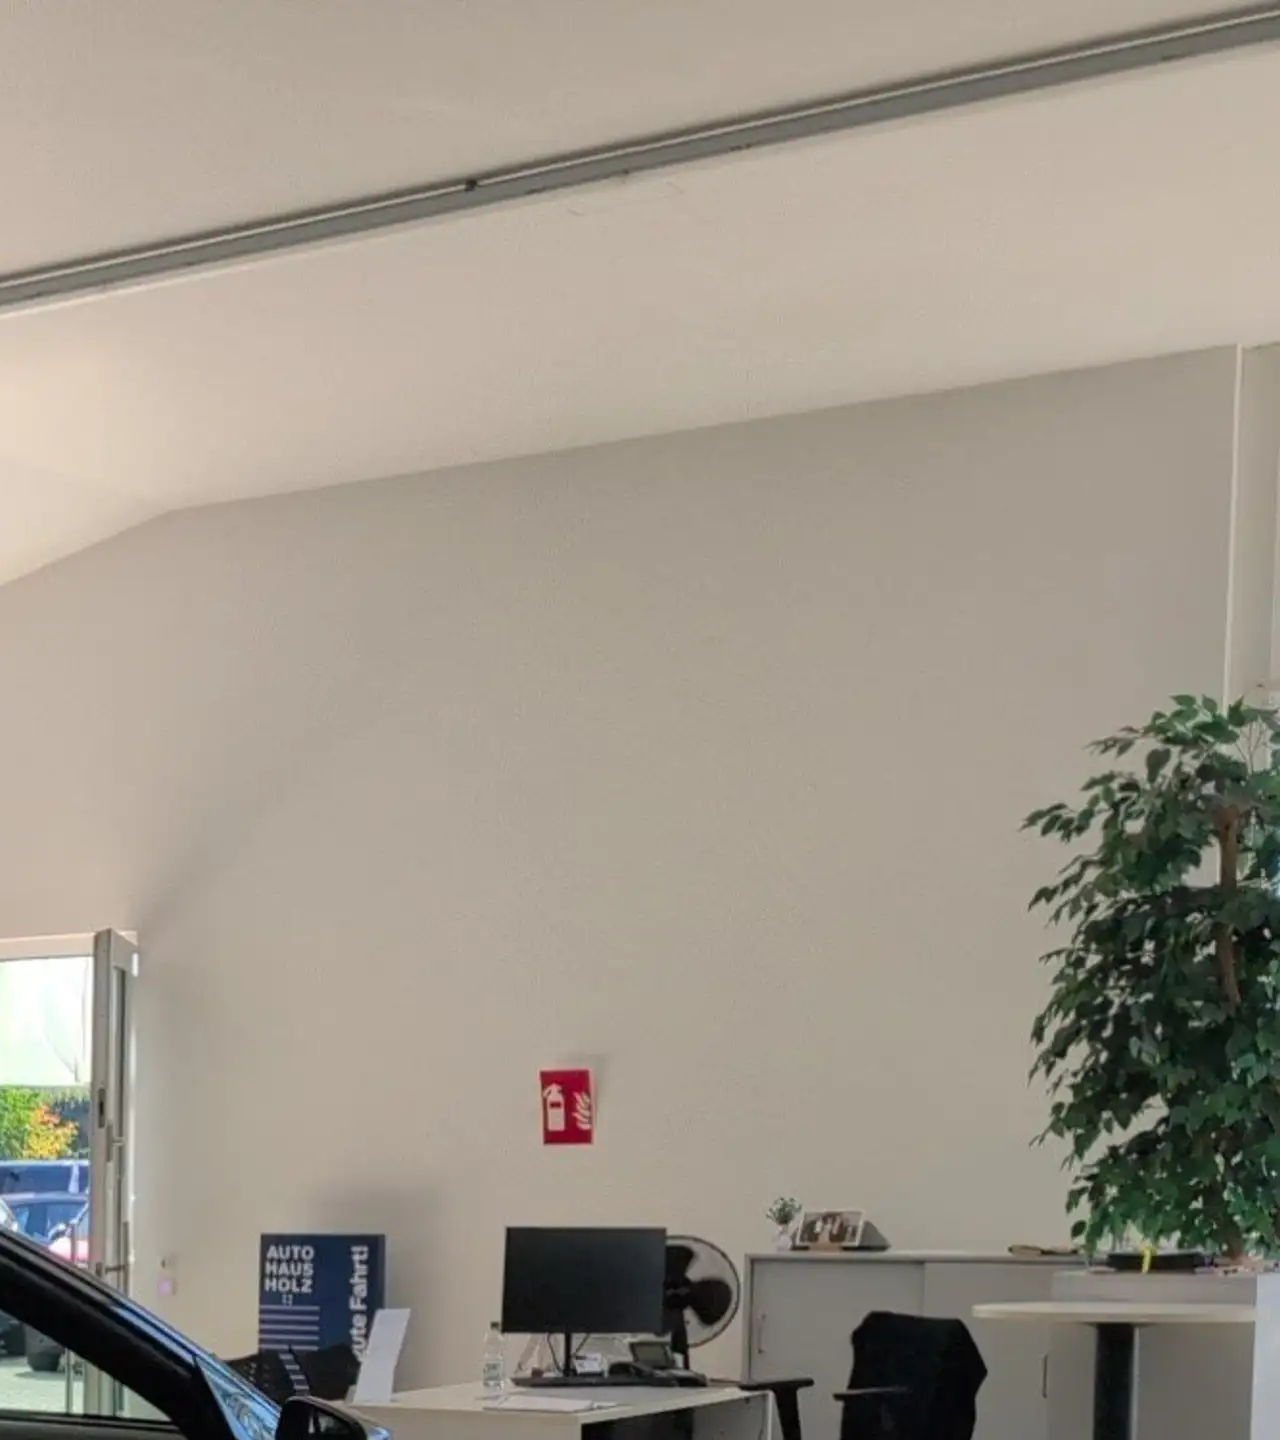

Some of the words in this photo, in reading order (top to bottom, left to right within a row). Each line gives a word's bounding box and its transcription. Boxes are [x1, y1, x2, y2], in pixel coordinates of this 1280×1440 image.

[267, 1245, 314, 1260] AUTO
[265, 1261, 314, 1276] HAUS
[264, 1277, 312, 1292] HOLZ
[349, 1246, 369, 1311] Fahrt!
